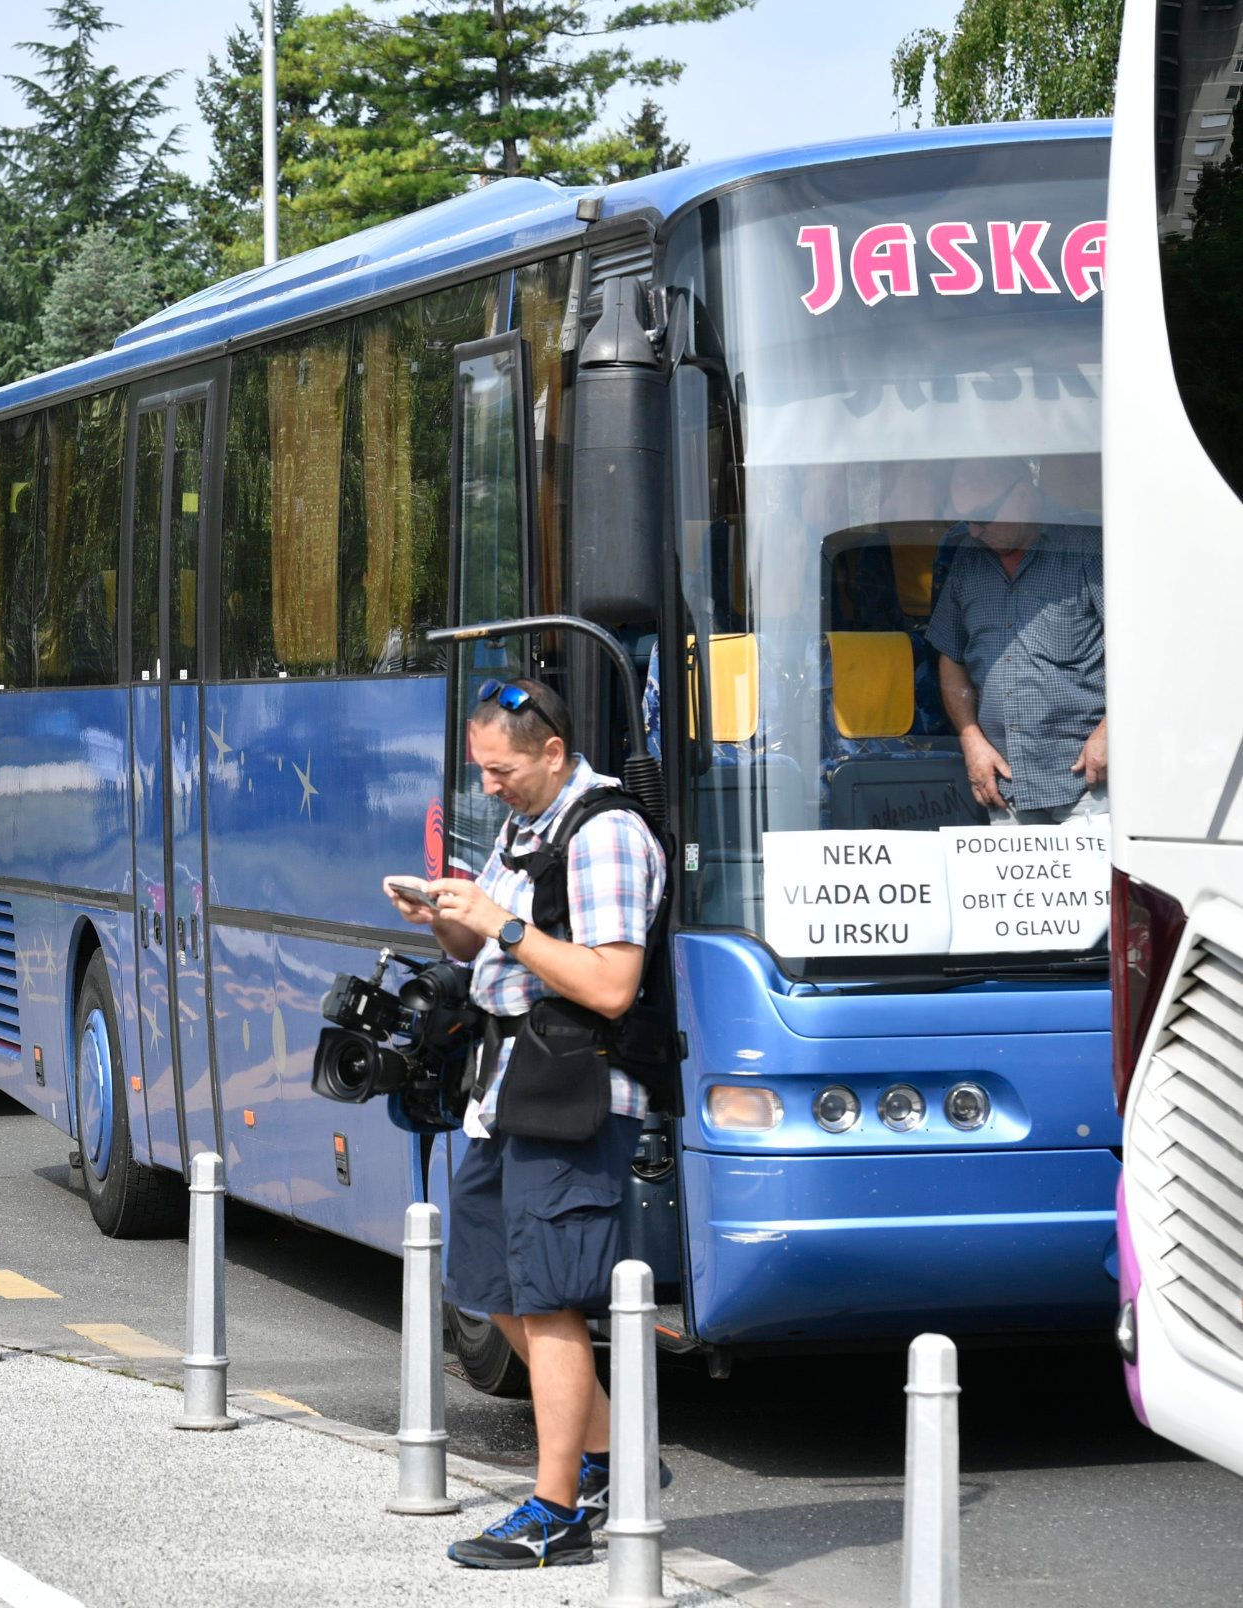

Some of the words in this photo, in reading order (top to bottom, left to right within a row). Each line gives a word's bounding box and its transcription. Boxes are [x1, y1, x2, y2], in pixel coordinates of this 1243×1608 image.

[796, 220, 1108, 315] JASKA
[823, 844, 892, 865] NEKA
[956, 837, 1069, 854] PODCIJENILI
[1075, 837, 1107, 851] STE
[996, 860, 1072, 880] VOZAČE
[783, 884, 870, 905] VLADA
[878, 883, 931, 904] ODE
[962, 893, 1007, 909] OBIT
[1013, 888, 1036, 908] ĆE
[1041, 891, 1087, 907] VAM
[808, 923, 825, 944] U
[835, 923, 908, 944] IRSKU
[995, 921, 1009, 936] O
[1015, 919, 1080, 936] GLAVU
